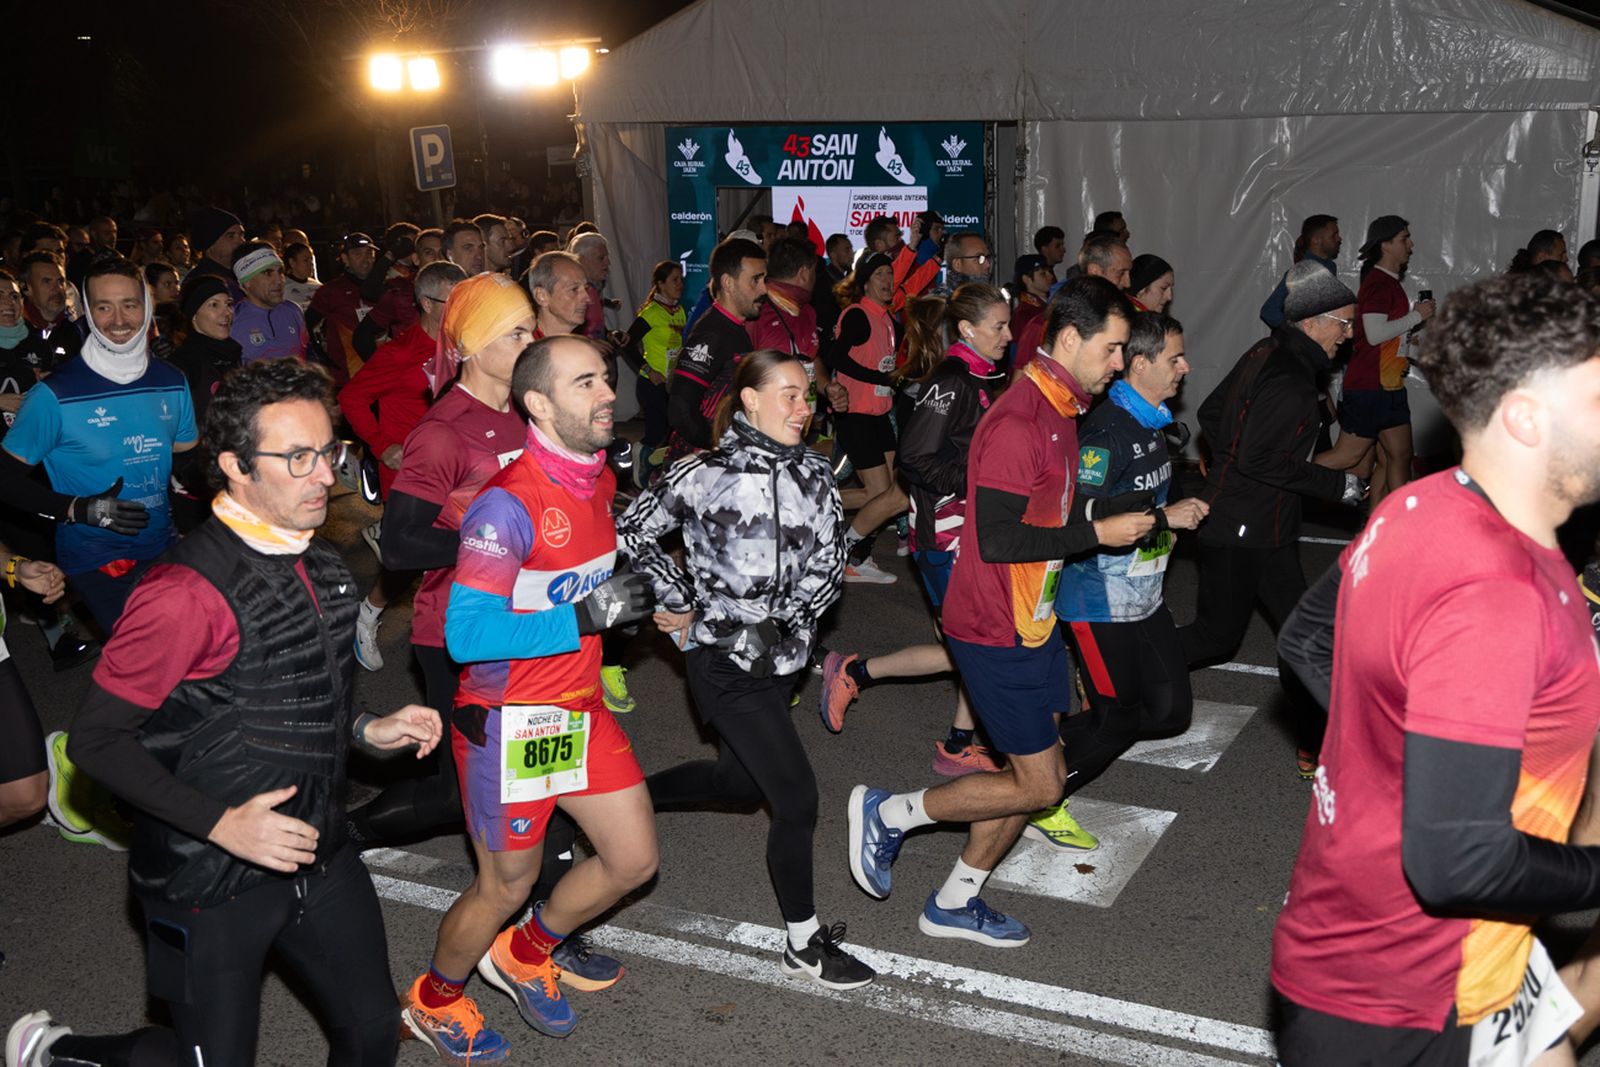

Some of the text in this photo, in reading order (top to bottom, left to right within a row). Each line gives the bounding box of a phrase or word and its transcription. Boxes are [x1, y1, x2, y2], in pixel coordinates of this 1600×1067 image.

[783, 133, 858, 158] 43 SAN
[420, 133, 445, 182] P
[777, 152, 855, 181] ANTÓN
[886, 158, 903, 176] 43
[735, 159, 751, 176] 43
[852, 202, 888, 210] NOCHE DE
[1133, 470, 1160, 491] SAN
[527, 714, 552, 726] NOCHE
[553, 712, 563, 723] DE
[514, 727, 534, 740] SAN
[523, 734, 573, 769] 8675
